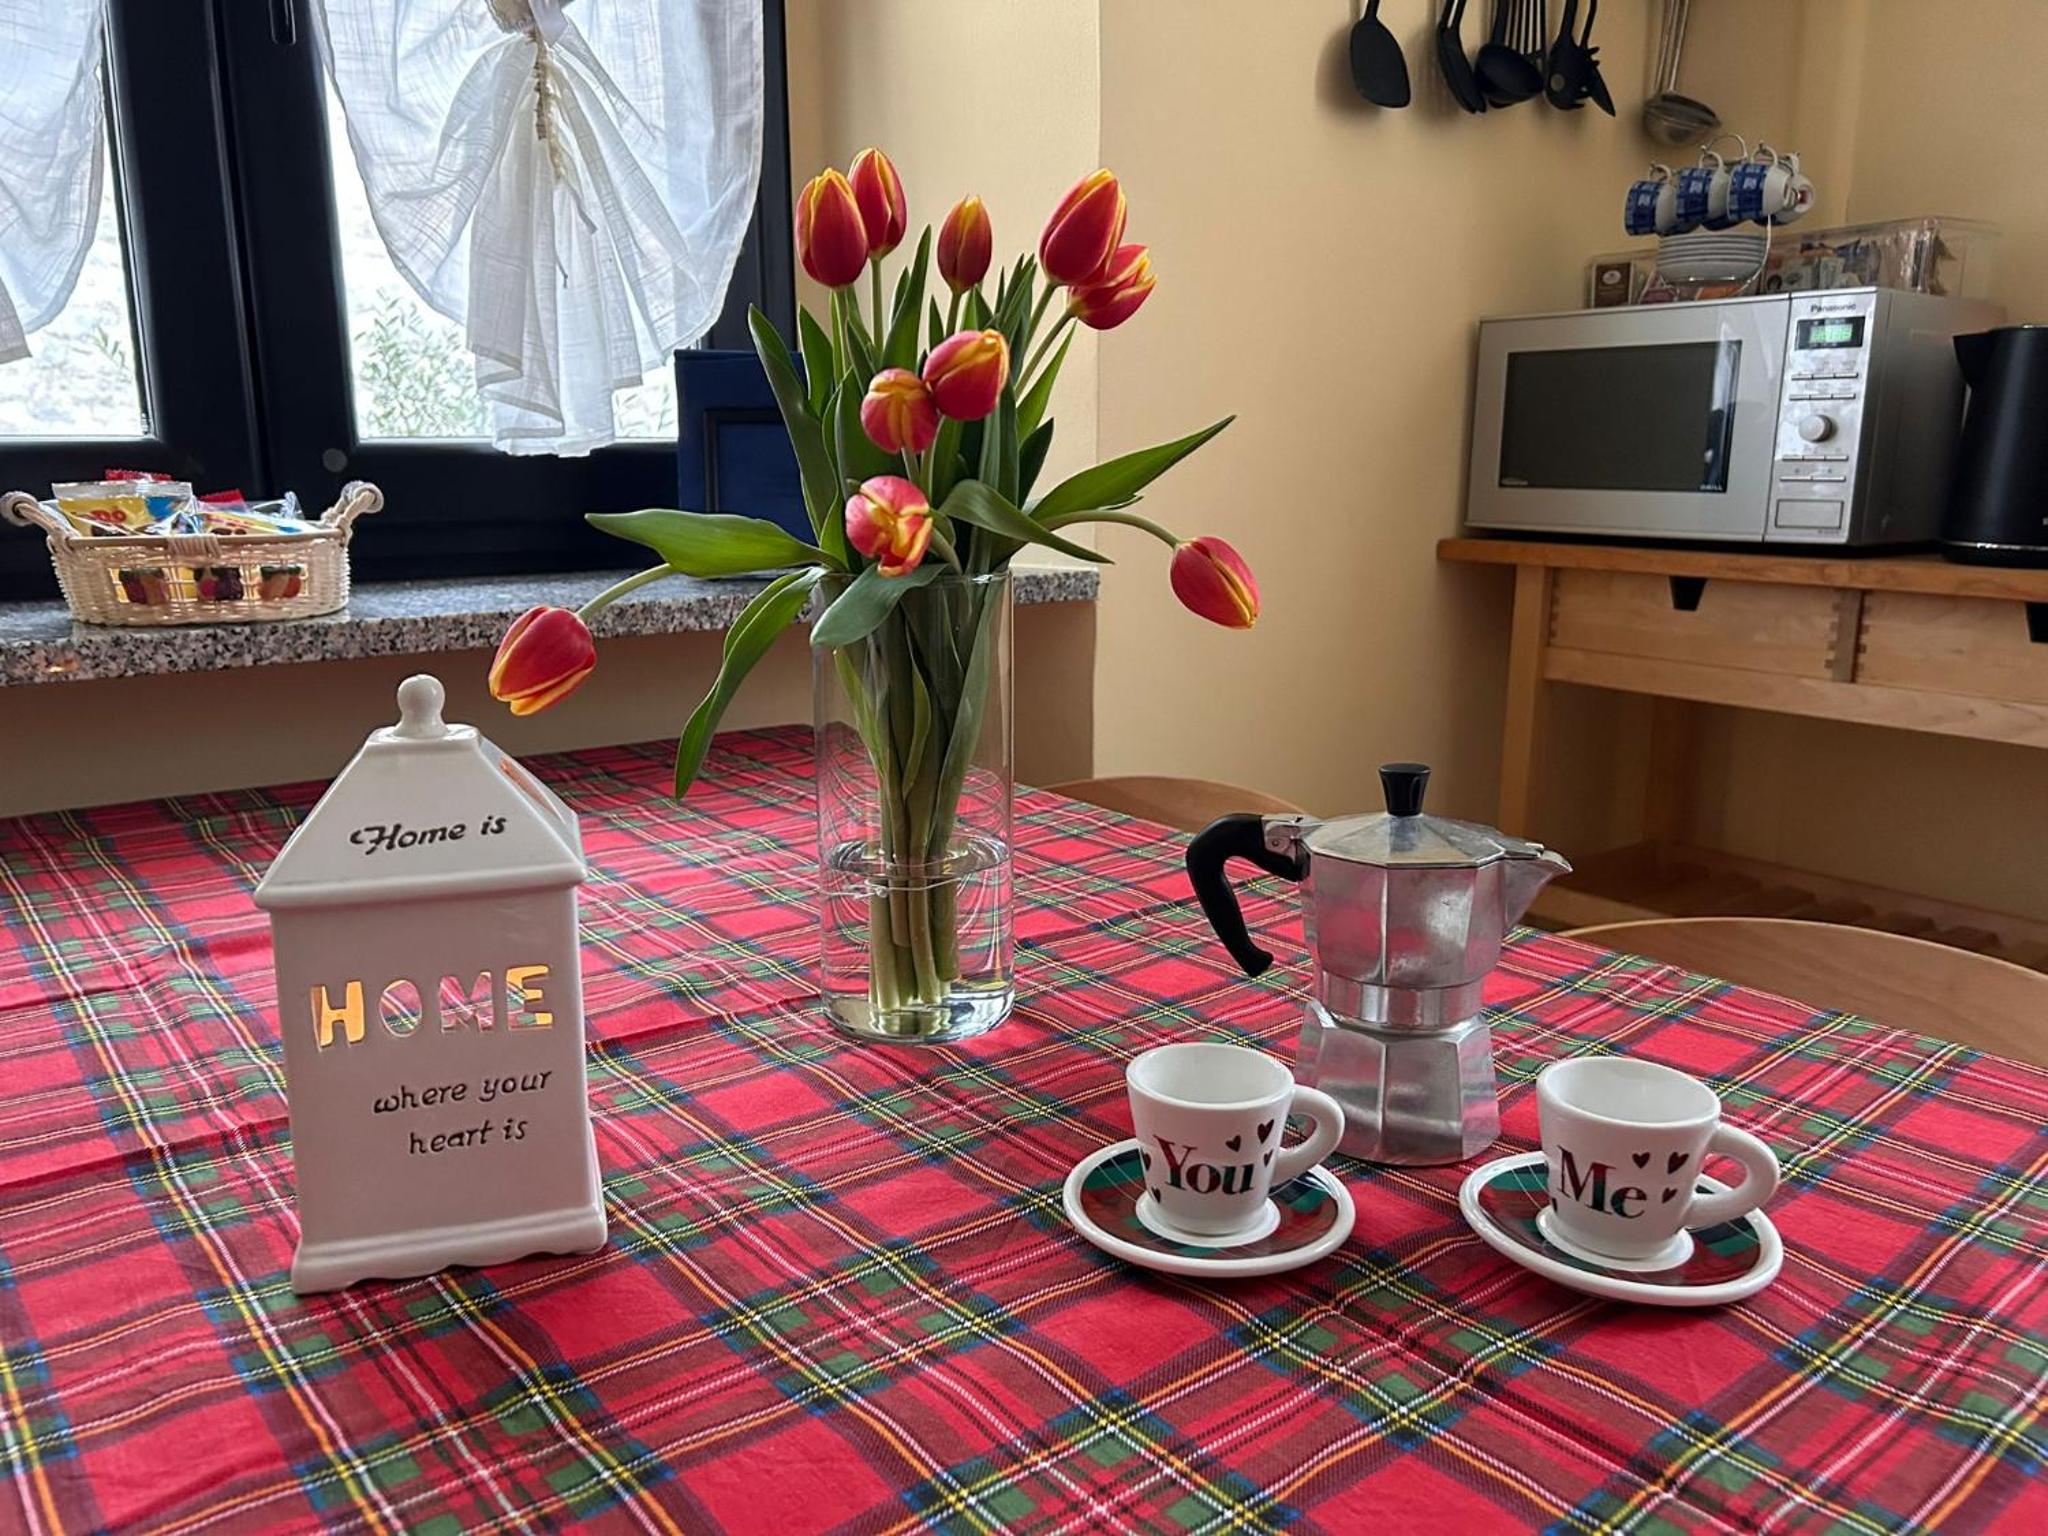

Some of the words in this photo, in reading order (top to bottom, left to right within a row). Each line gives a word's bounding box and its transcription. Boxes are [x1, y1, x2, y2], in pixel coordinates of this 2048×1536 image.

[350, 824, 466, 855] Home
[480, 815, 507, 835] is
[310, 965, 553, 1050] HOME
[373, 1085, 467, 1114] where
[479, 1070, 553, 1102] your
[409, 1119, 491, 1154] heart
[503, 1118, 527, 1139] is
[1154, 1135, 1255, 1195] You
[1556, 1144, 1648, 1219] Me
